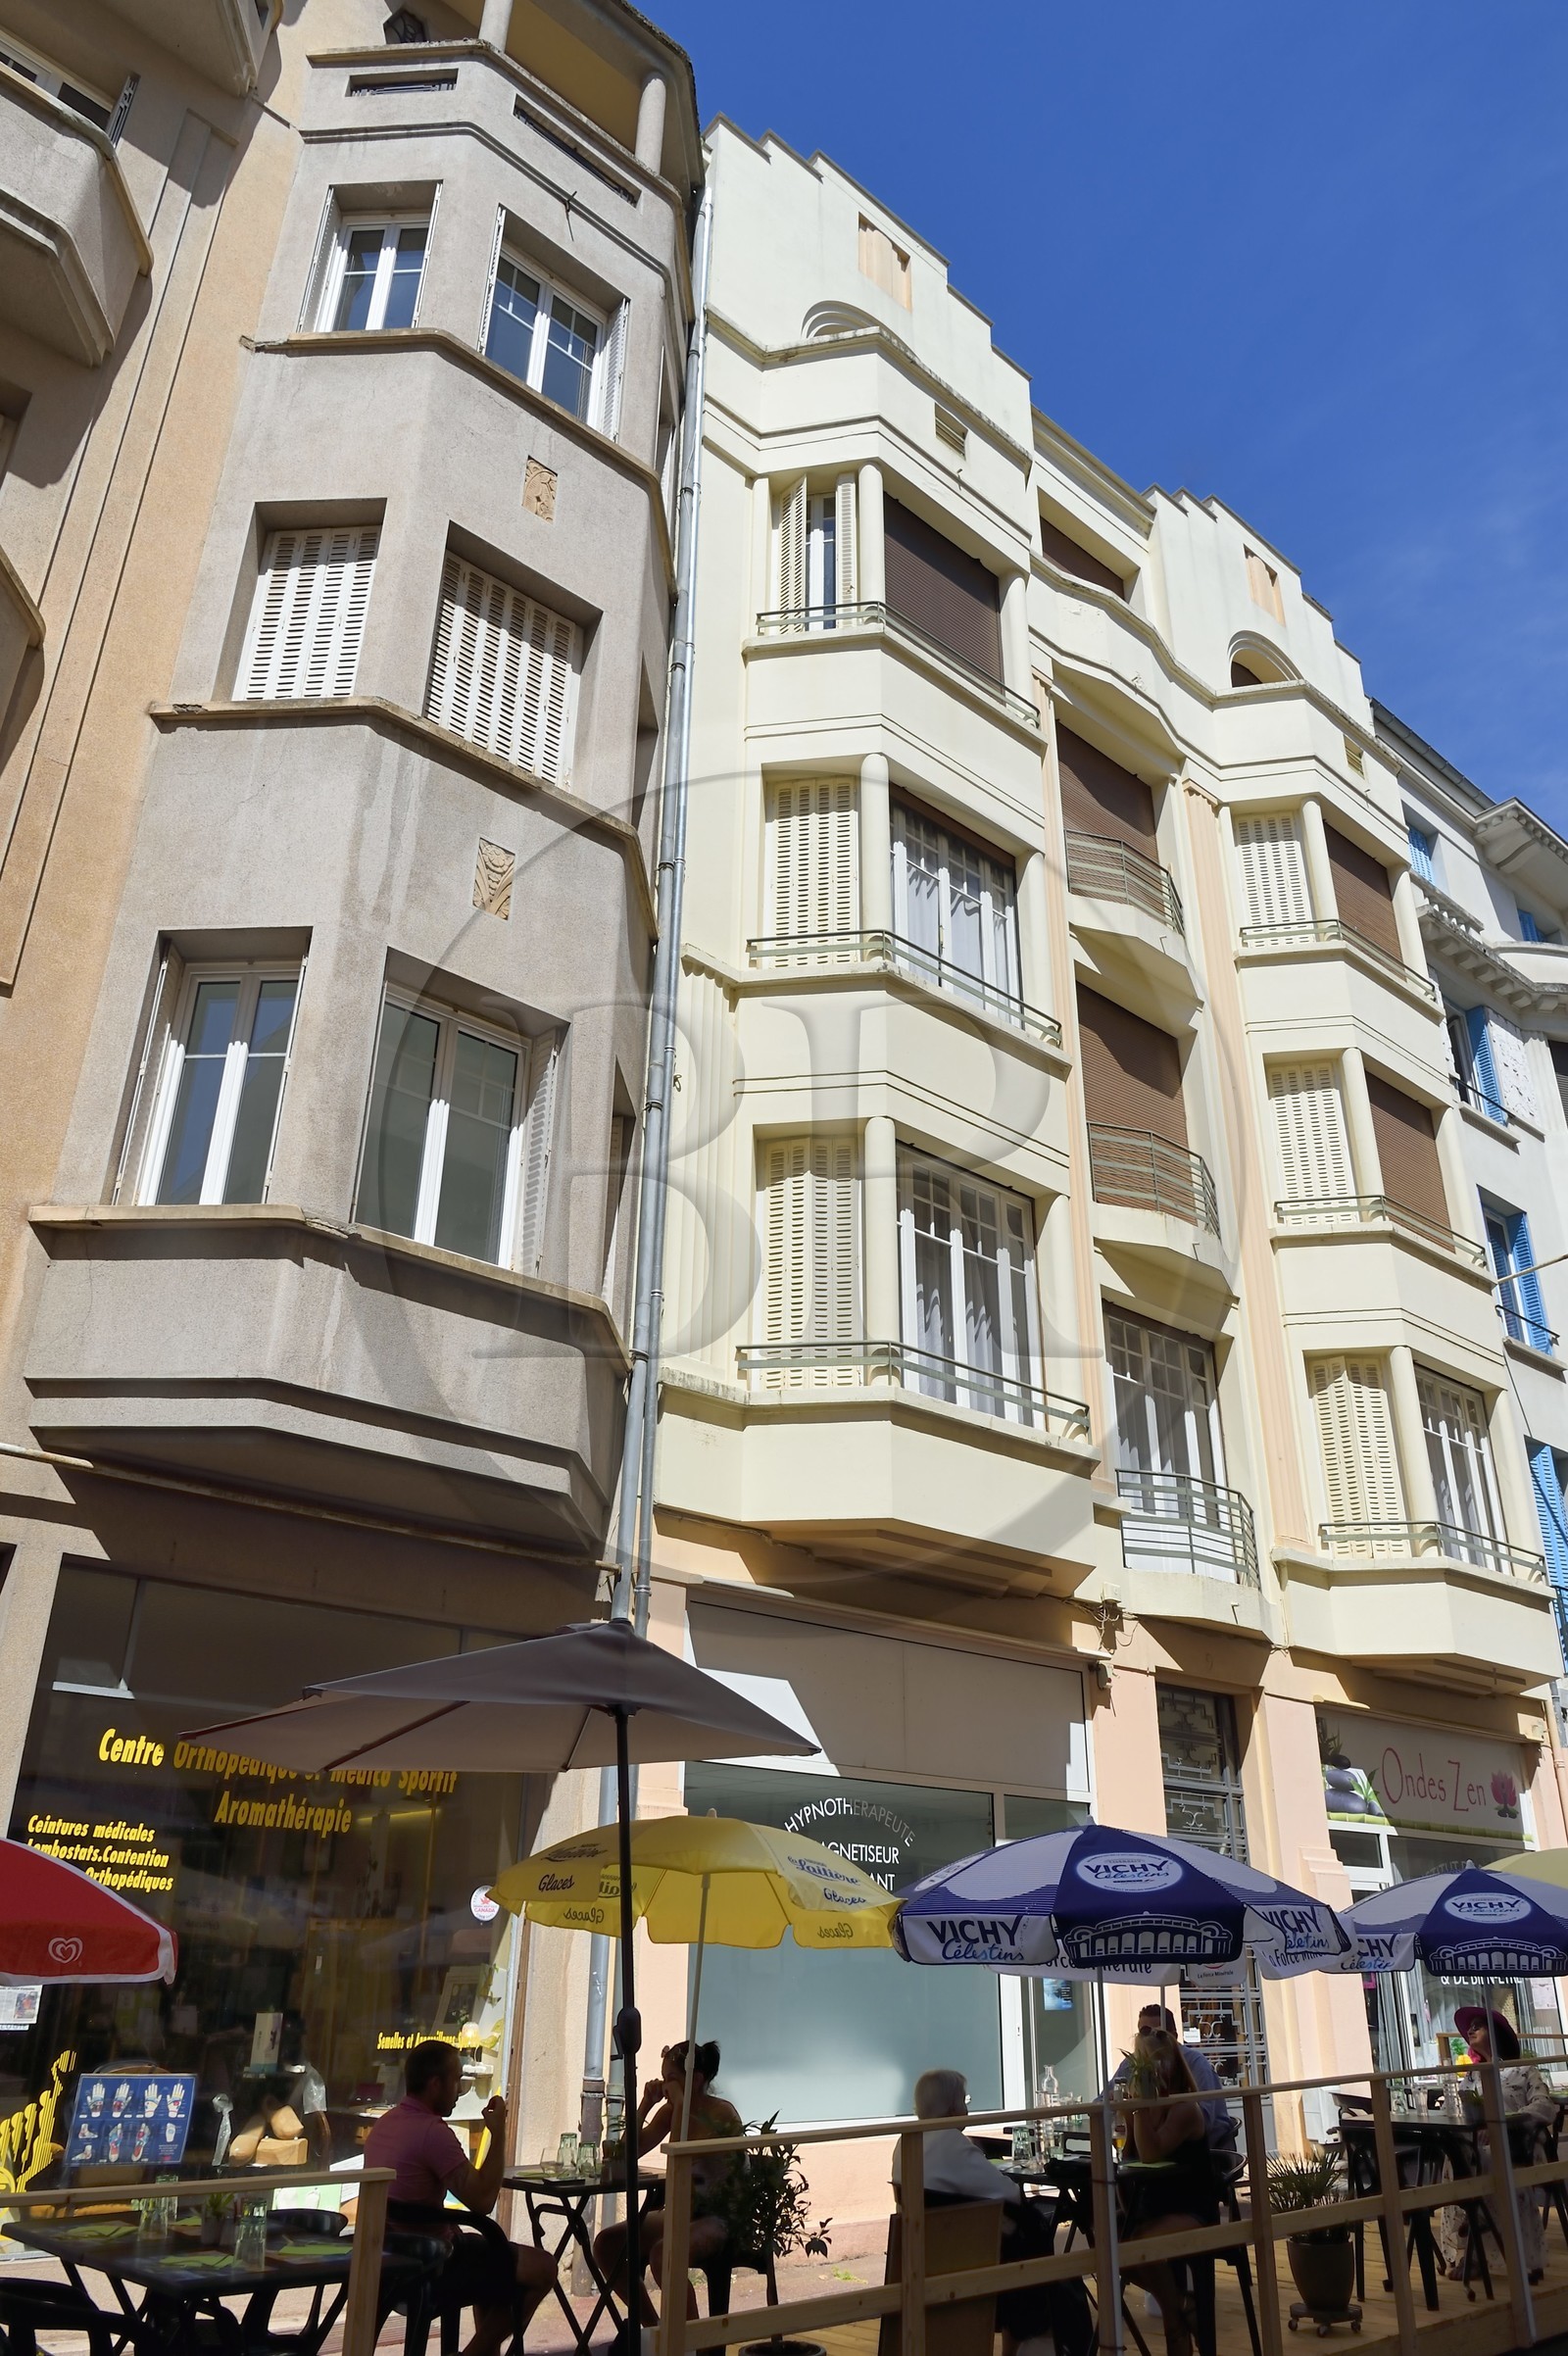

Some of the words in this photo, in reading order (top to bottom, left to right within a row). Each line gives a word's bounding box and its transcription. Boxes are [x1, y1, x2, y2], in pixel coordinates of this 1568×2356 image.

[99, 1728, 165, 1767] Centre
[1382, 1747, 1446, 1804] Ondes
[1447, 1760, 1487, 1812] Zen
[214, 1790, 353, 1840] Aromathérapie
[784, 1797, 916, 1847] HYPNOTHERAPEUTE
[27, 1814, 90, 1838] Ceintures
[92, 1821, 156, 1843] médicales
[821, 1841, 900, 1864] GNETISEUR
[1083, 1859, 1169, 1874] VICHY
[538, 1873, 575, 1892] Glaces
[823, 1888, 867, 1905] Glaces
[1451, 1898, 1521, 1909] VICHY
[926, 1914, 1025, 1946] VICHY
[941, 1938, 1025, 1961] Célestins
[376, 2031, 406, 2050] Semelles
[406, 2033, 415, 2049] et
